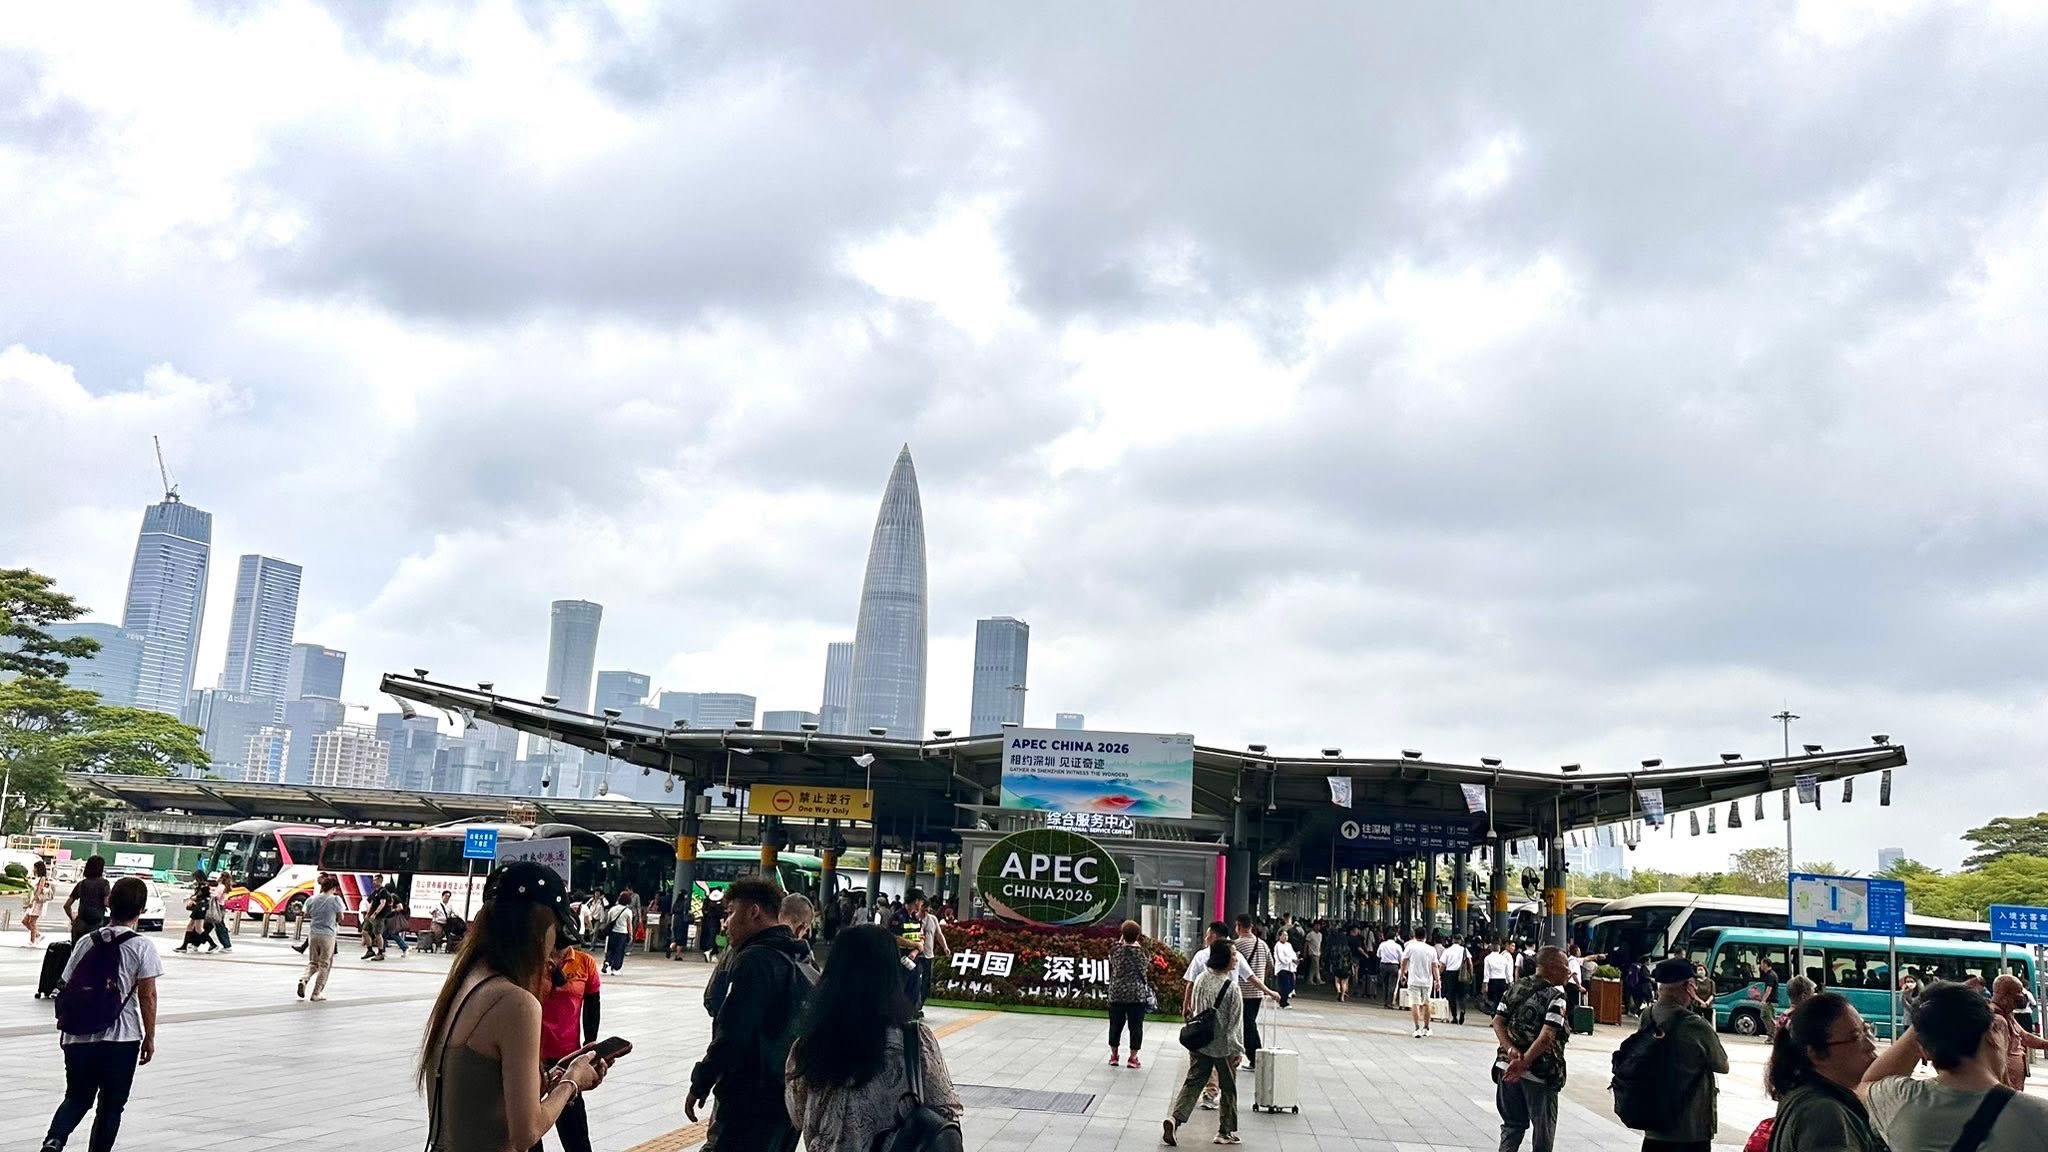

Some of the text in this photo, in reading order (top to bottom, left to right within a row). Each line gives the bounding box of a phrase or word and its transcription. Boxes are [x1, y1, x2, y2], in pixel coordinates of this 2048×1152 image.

[1011, 738, 1129, 754] APEC CHINA 2026
[1010, 754, 1105, 770] 相约深圳 见证奇迹
[799, 791, 851, 806] 禁止逆行
[798, 805, 850, 815] One Way Only
[1046, 811, 1134, 830] 综合服务中心
[999, 851, 1099, 885] APEC
[1002, 884, 1093, 902] CHINA2026
[950, 948, 1110, 985] 中国 深圳
